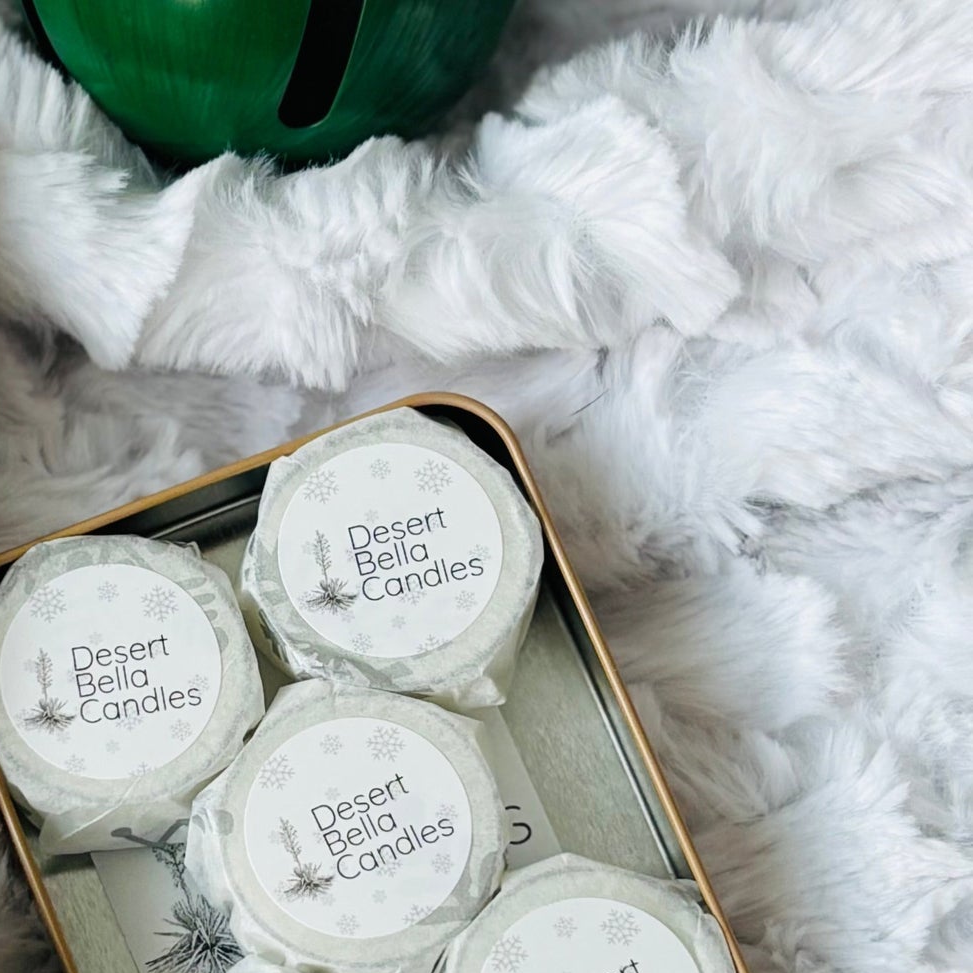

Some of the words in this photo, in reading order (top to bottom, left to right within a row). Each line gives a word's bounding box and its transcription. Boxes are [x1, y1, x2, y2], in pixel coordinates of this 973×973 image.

[348, 507, 447, 550] Desert
[354, 541, 429, 576] Bella
[362, 558, 484, 601] Candles
[71, 634, 169, 672] Desert
[75, 665, 148, 698] Bella
[80, 686, 202, 724] Candles
[311, 773, 409, 831] Desert
[323, 812, 397, 856] Bella
[337, 818, 455, 879] Candles
